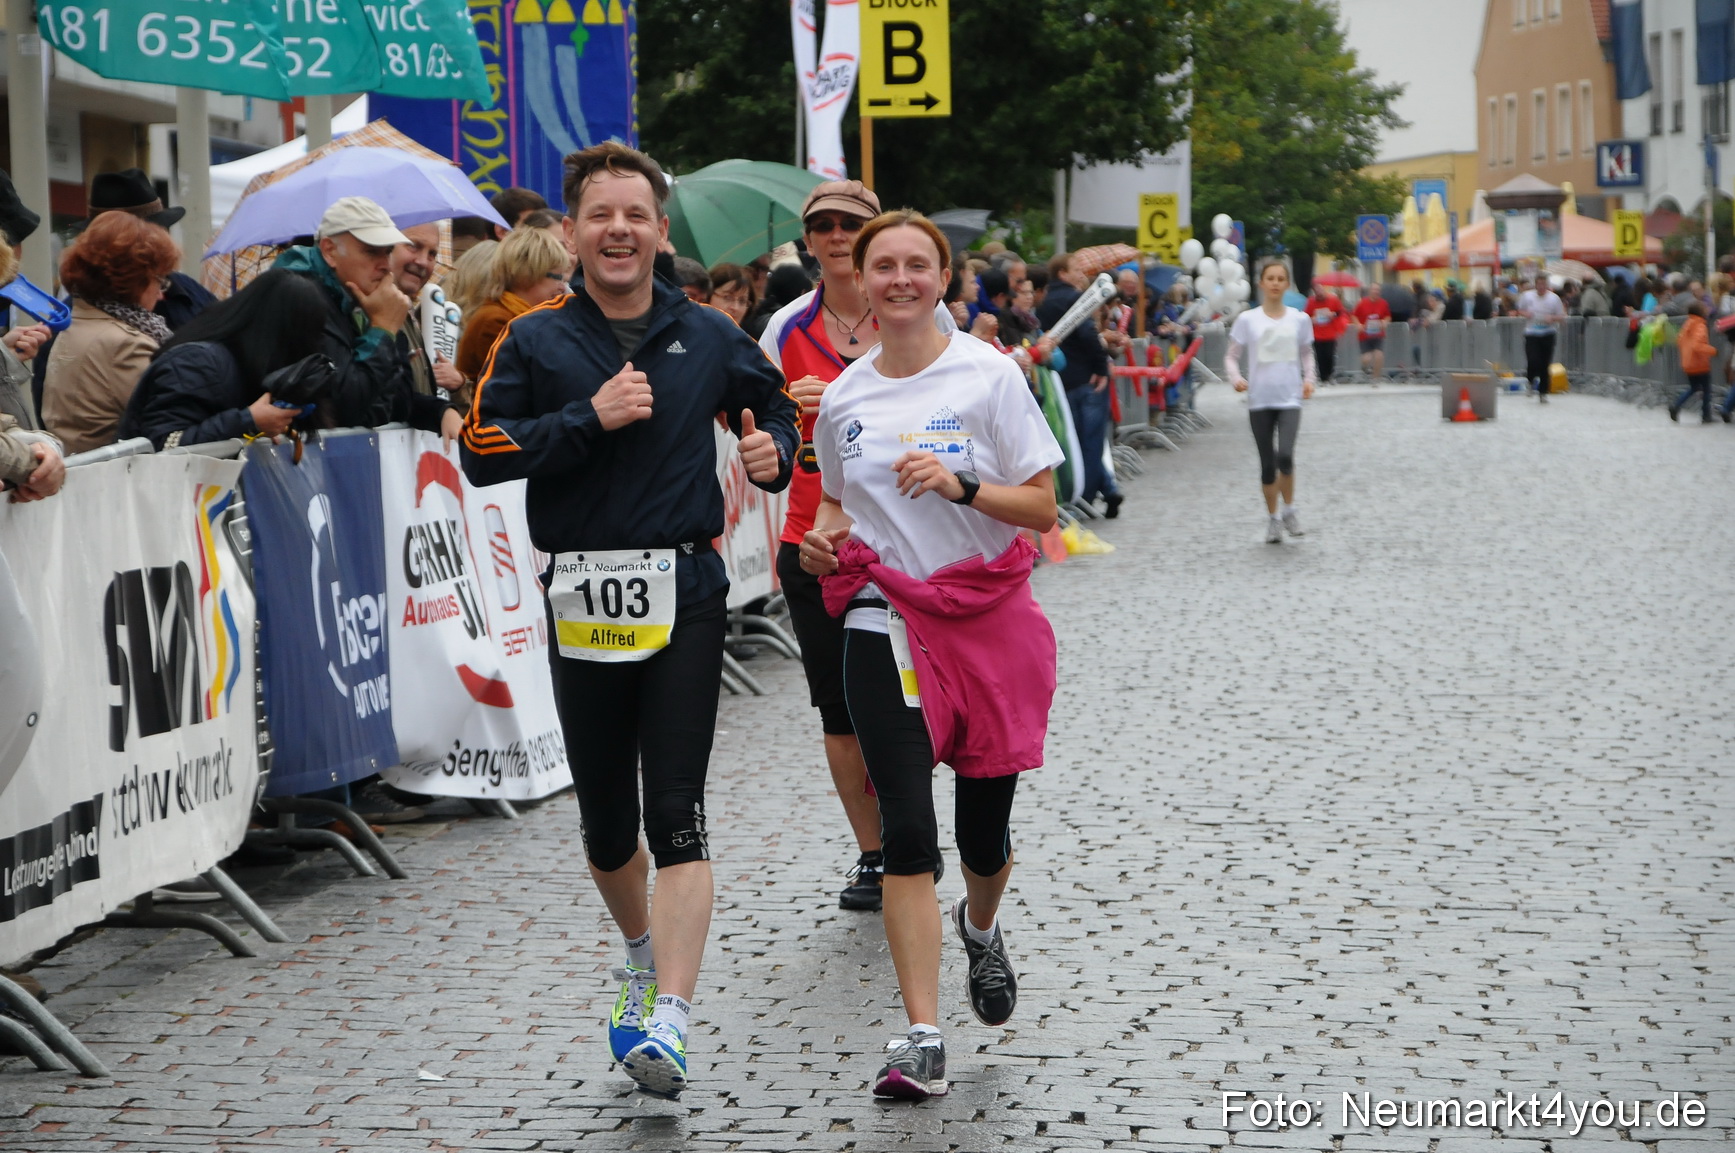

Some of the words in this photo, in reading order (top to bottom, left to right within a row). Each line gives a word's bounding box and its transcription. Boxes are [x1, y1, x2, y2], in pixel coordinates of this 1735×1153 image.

[883, 20, 927, 85] B
[1148, 209, 1169, 239] C
[1622, 222, 1638, 246] D
[899, 433, 917, 443] 14.
[555, 563, 591, 575] PARTL
[594, 561, 652, 573] Neumarkt
[574, 577, 650, 619] 103
[558, 611, 564, 619] D
[590, 628, 636, 647] Alfred
[628, 933, 651, 949] SOCKS
[656, 997, 673, 1006] TECH
[675, 999, 691, 1015] SOCKS
